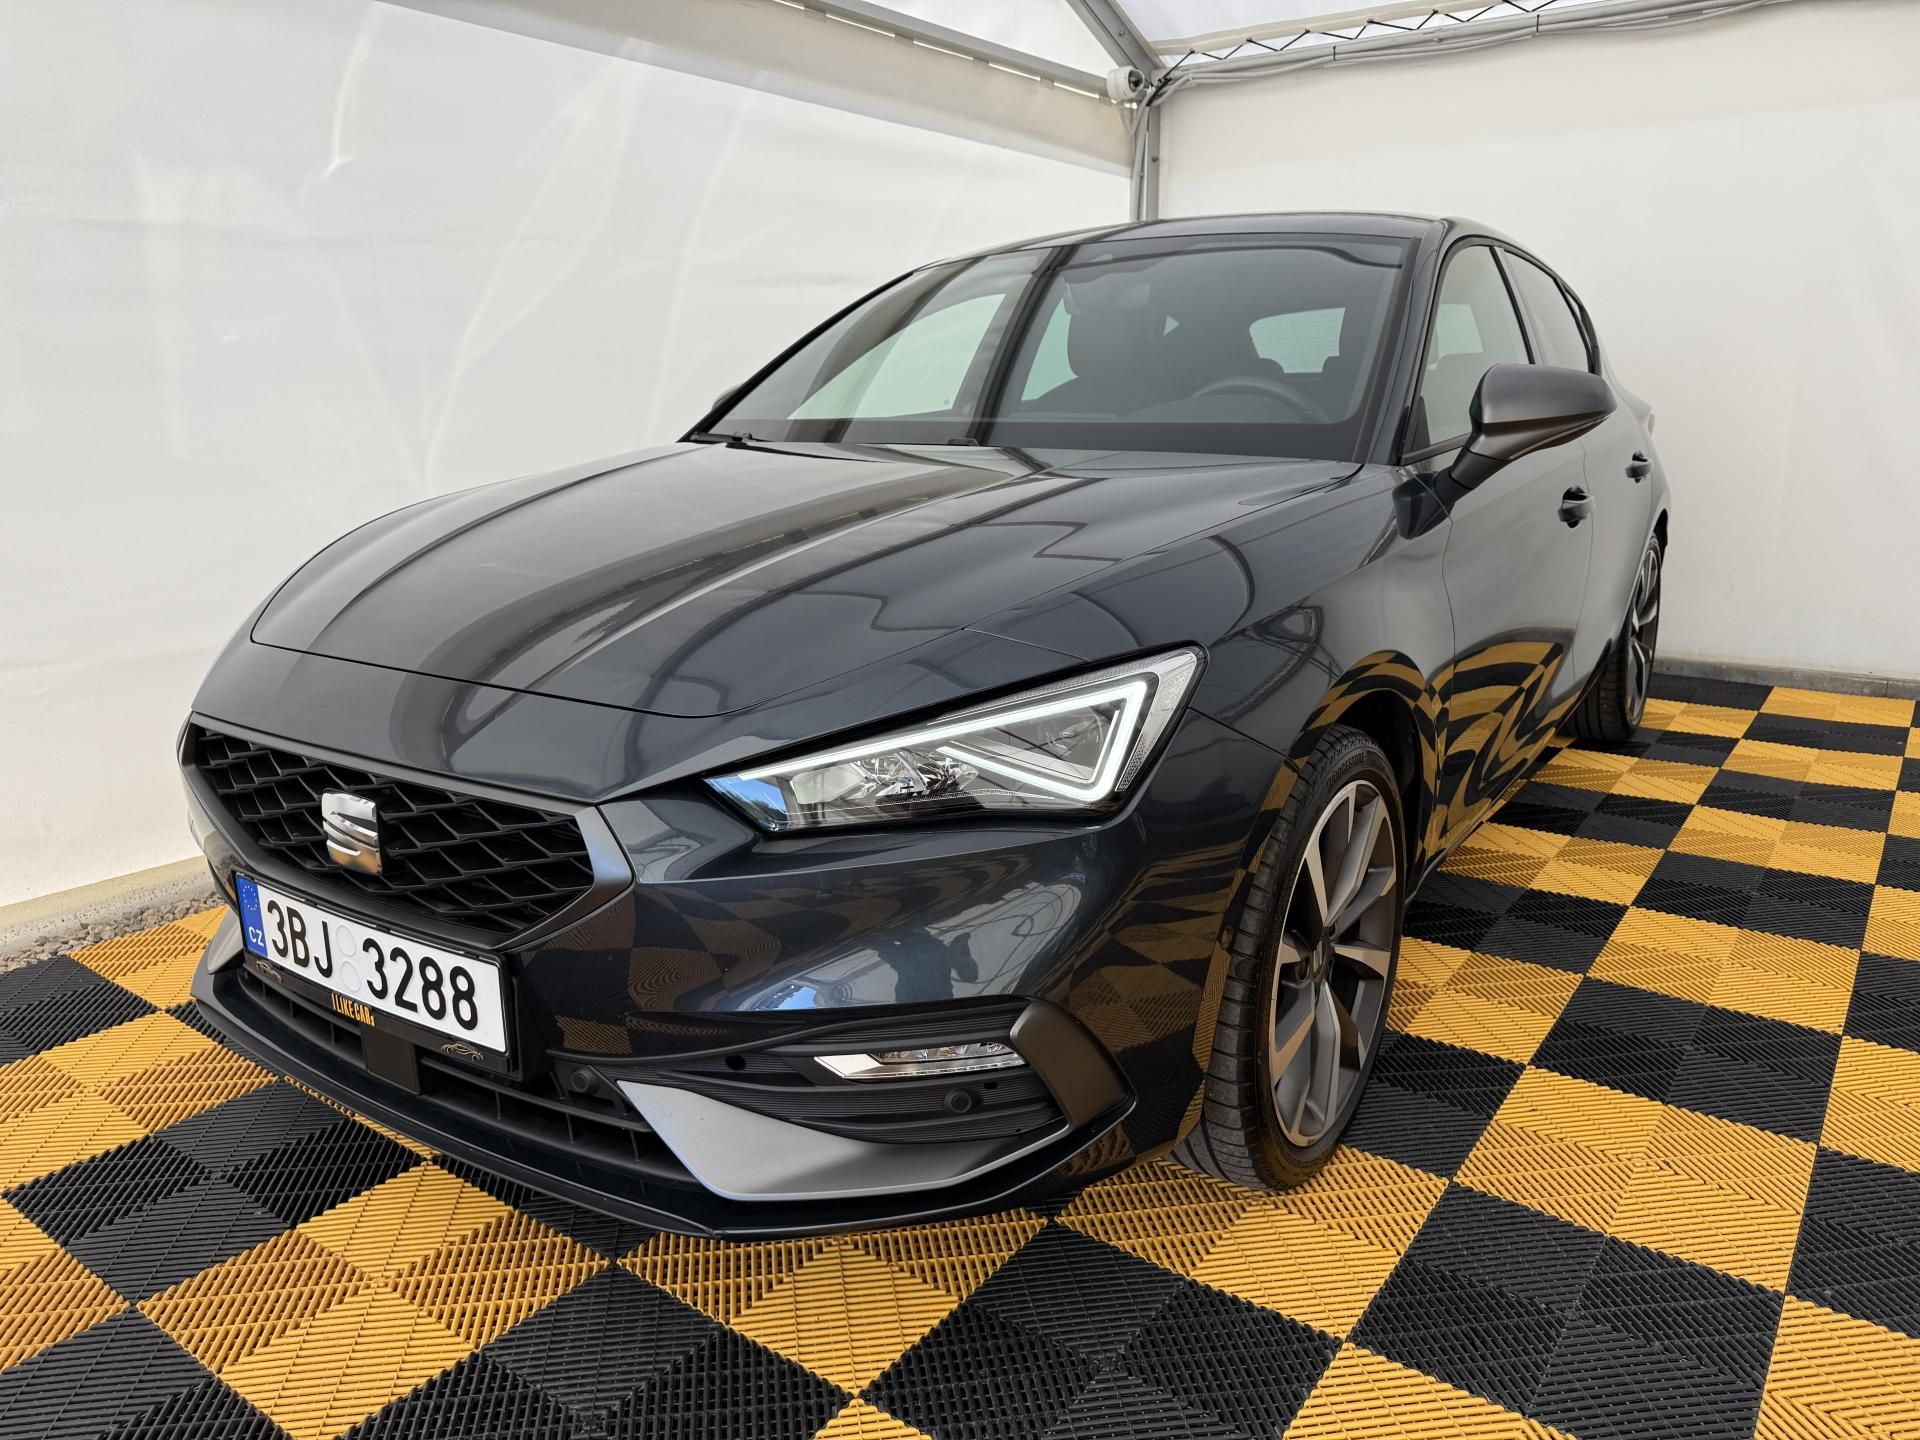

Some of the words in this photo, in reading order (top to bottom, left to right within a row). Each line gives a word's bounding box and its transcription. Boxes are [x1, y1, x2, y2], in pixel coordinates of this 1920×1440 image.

[248, 926, 264, 947] CZ
[267, 899, 333, 978] 3BJ
[362, 937, 479, 1031] 3288
[335, 994, 355, 1019] LIKE
